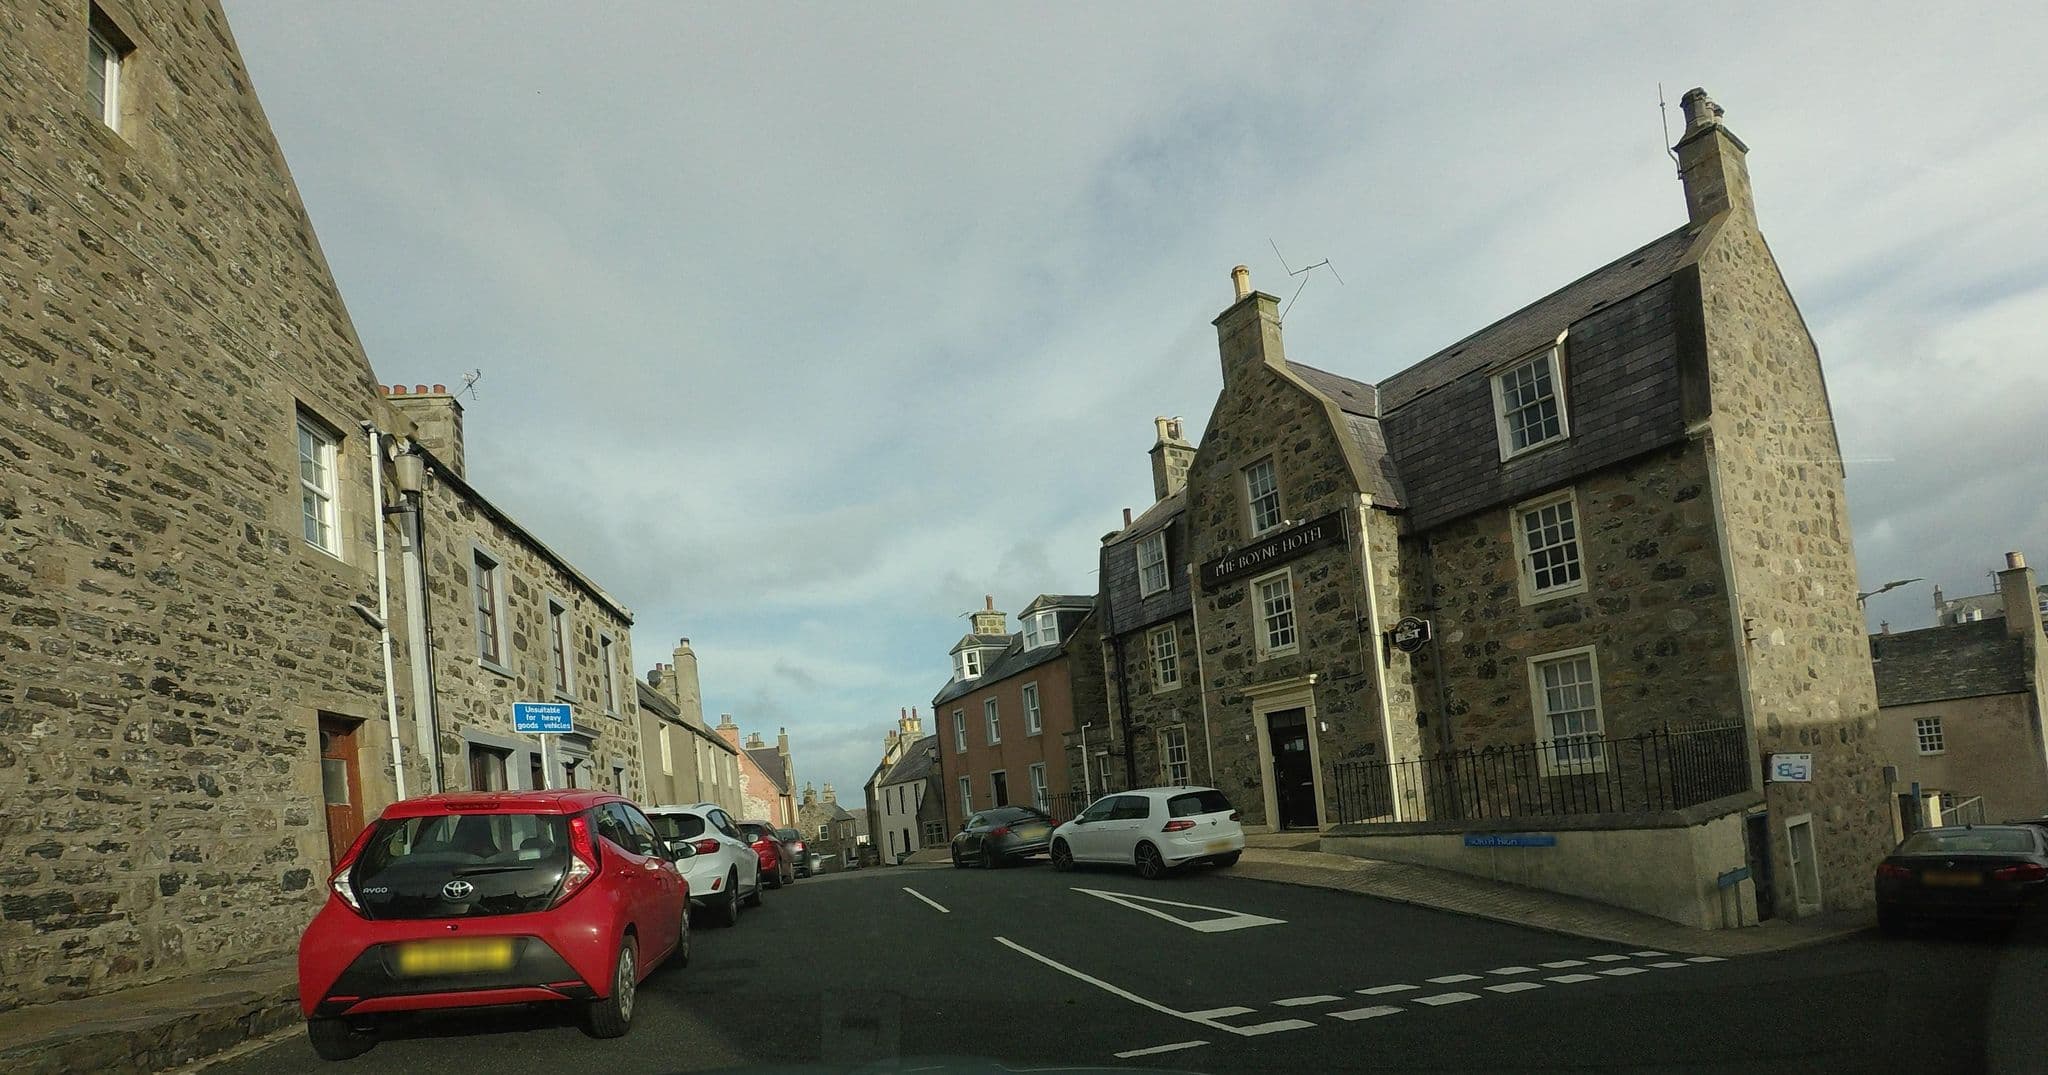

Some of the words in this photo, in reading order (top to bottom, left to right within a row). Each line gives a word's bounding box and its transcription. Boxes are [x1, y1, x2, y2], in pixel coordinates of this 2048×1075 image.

[1215, 560, 1235, 577] THE
[1239, 543, 1278, 568] BOYNE
[1282, 527, 1321, 552] HOTEL
[525, 706, 560, 714] Unsuitable
[541, 714, 561, 722] heavy
